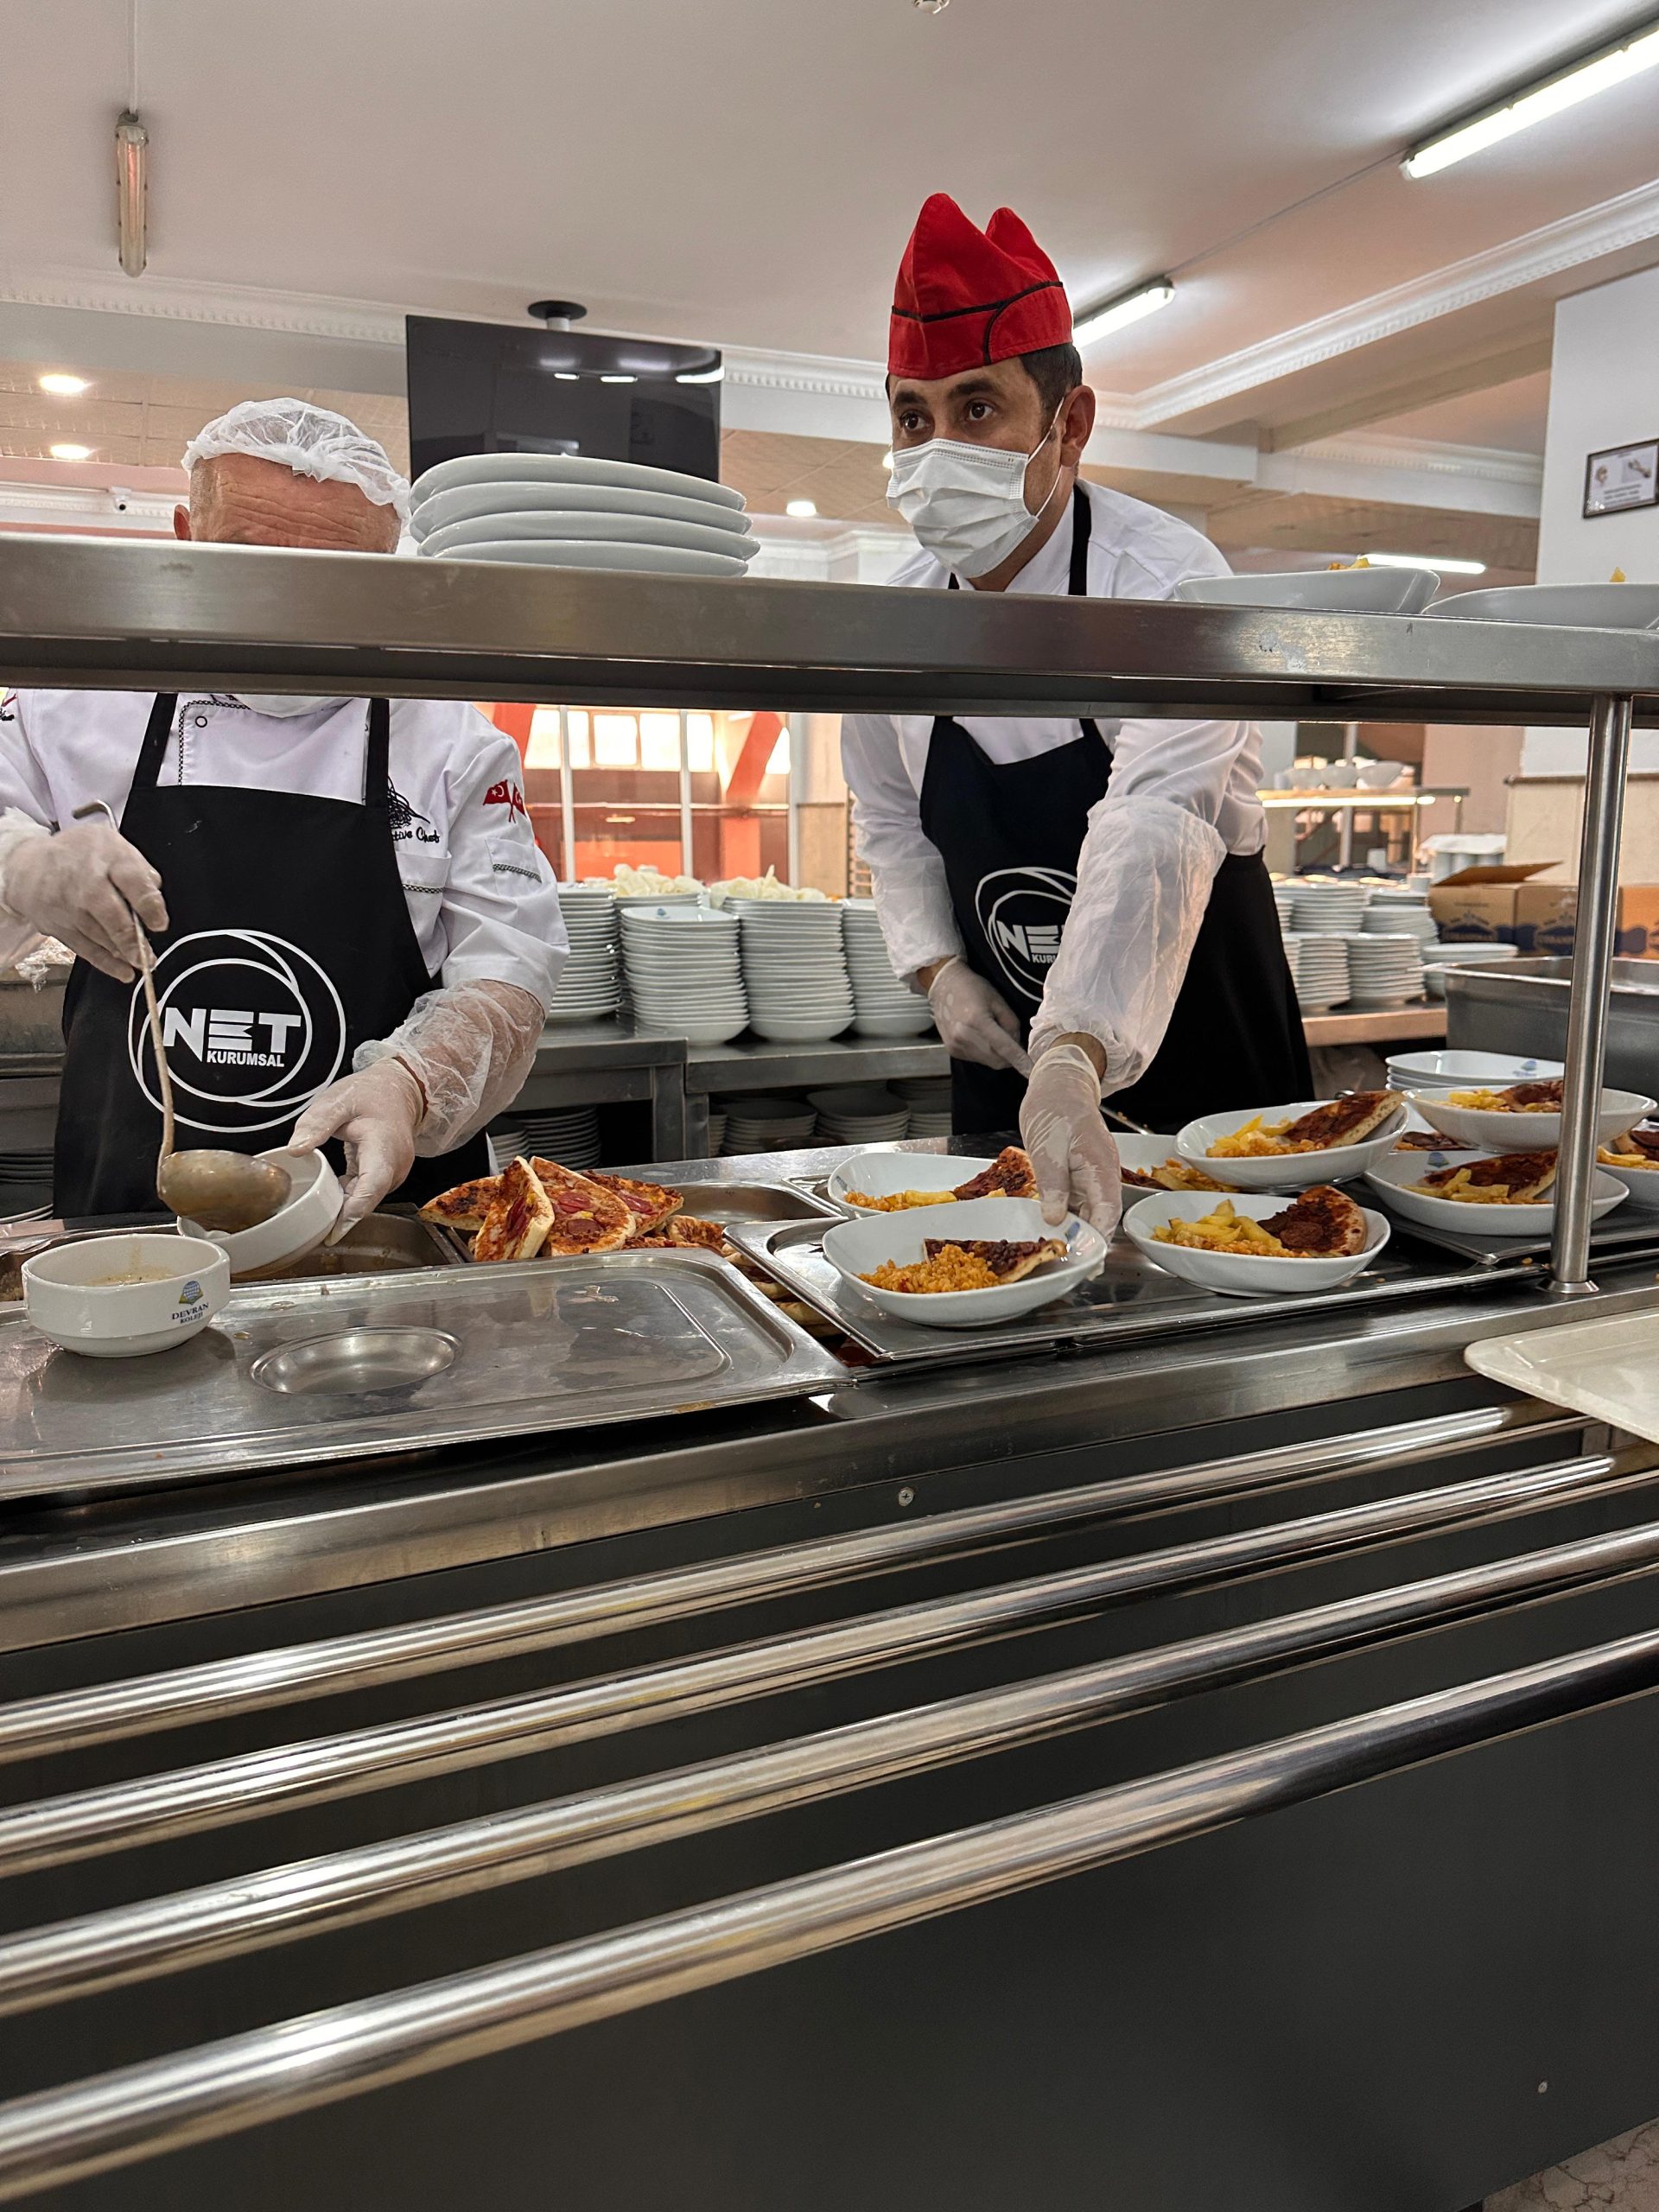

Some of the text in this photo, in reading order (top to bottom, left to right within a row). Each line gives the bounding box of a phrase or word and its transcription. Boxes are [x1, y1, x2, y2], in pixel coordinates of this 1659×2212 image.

[391, 830, 413, 842] tive
[996, 920, 1065, 963] NE
[162, 1007, 302, 1062] NET
[207, 1050, 285, 1067] KURUMSAL
[172, 1302, 209, 1320] DEVRAN
